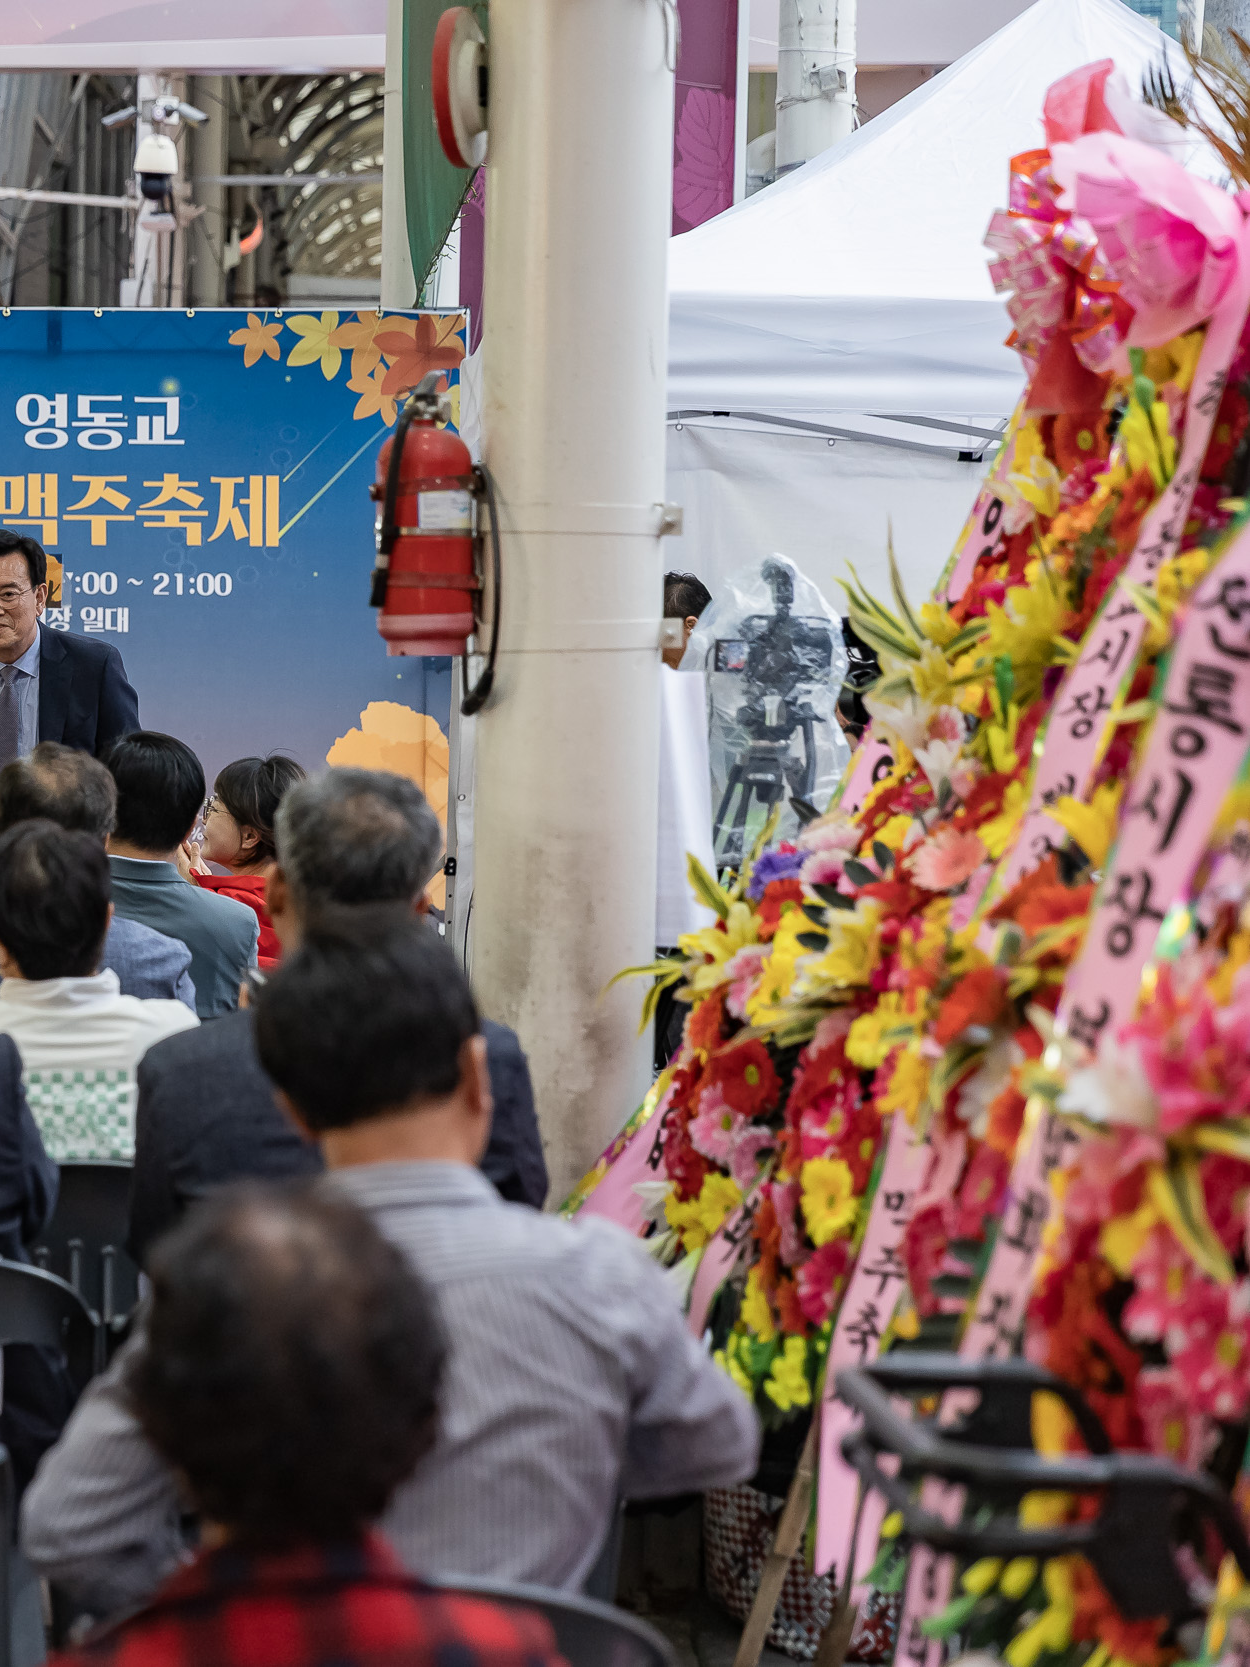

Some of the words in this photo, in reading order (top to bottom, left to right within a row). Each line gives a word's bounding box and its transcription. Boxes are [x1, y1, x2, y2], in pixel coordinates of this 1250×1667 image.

[15, 393, 185, 450] 영동교
[152, 572, 233, 597] 21:00
[80, 606, 129, 633] 일대
